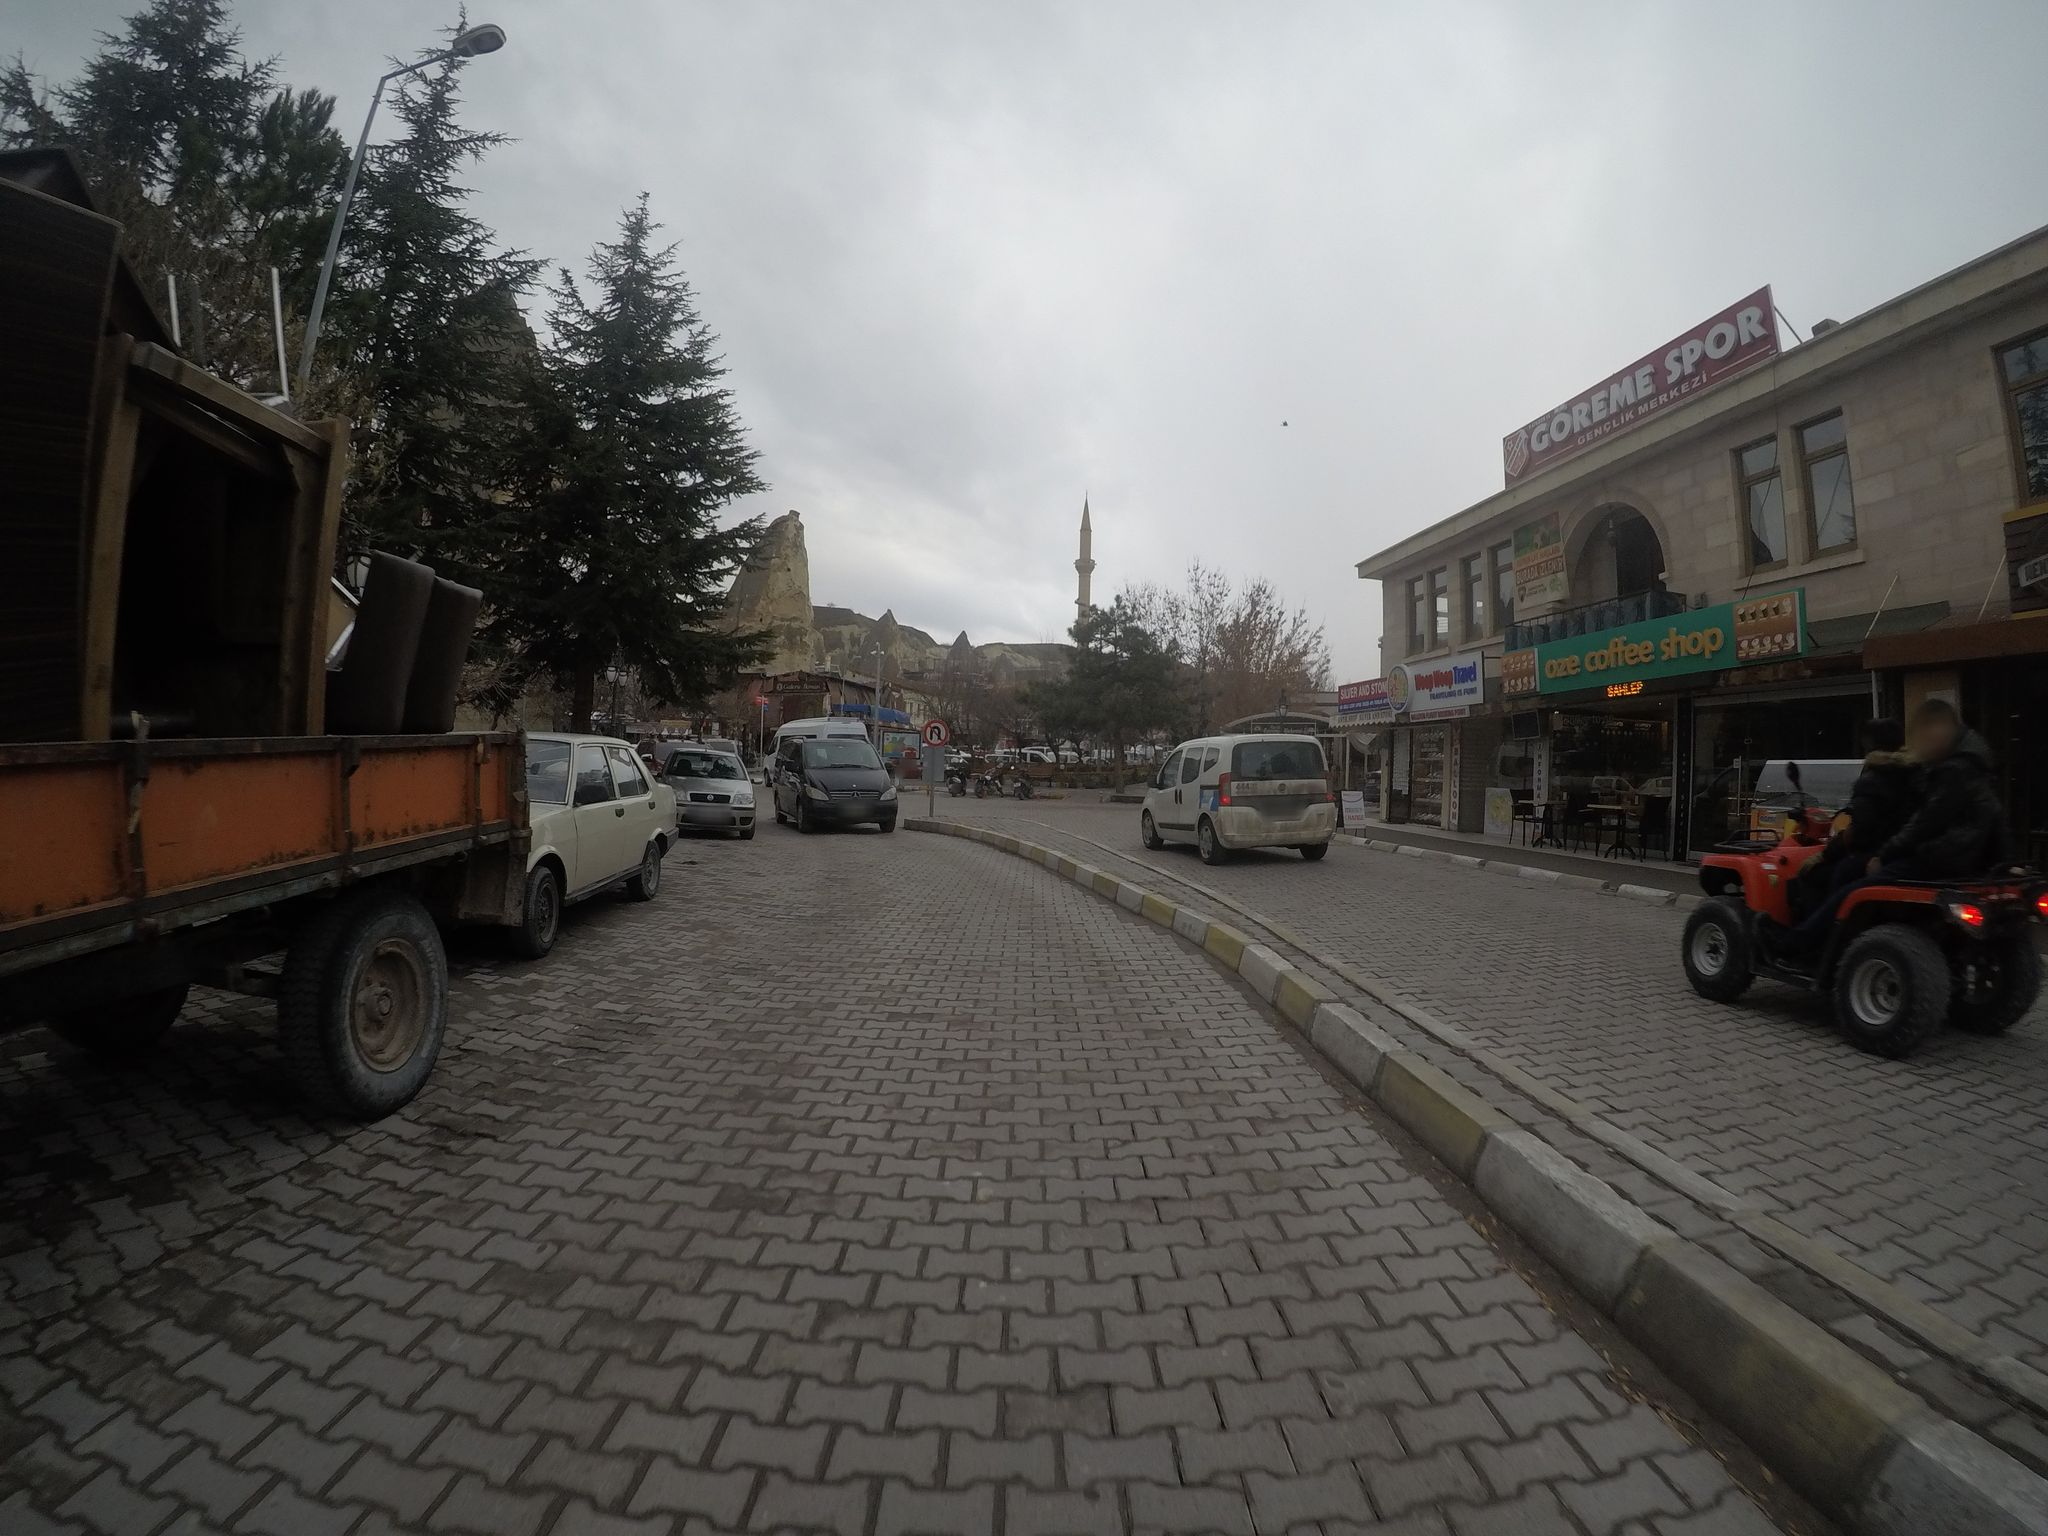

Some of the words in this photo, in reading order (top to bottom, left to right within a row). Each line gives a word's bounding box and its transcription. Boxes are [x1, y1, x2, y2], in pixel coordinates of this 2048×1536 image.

[1530, 363, 1657, 452] GÖREME
[1664, 305, 1769, 385] SPOR
[1577, 410, 1634, 446] GENÇLİK
[1638, 370, 1708, 415] MERKEZİ
[1453, 661, 1477, 684] Travel
[1545, 654, 1581, 679] oze
[1584, 635, 1655, 672] coffee
[1660, 627, 1725, 661] shop
[1358, 684, 1370, 697] AND
